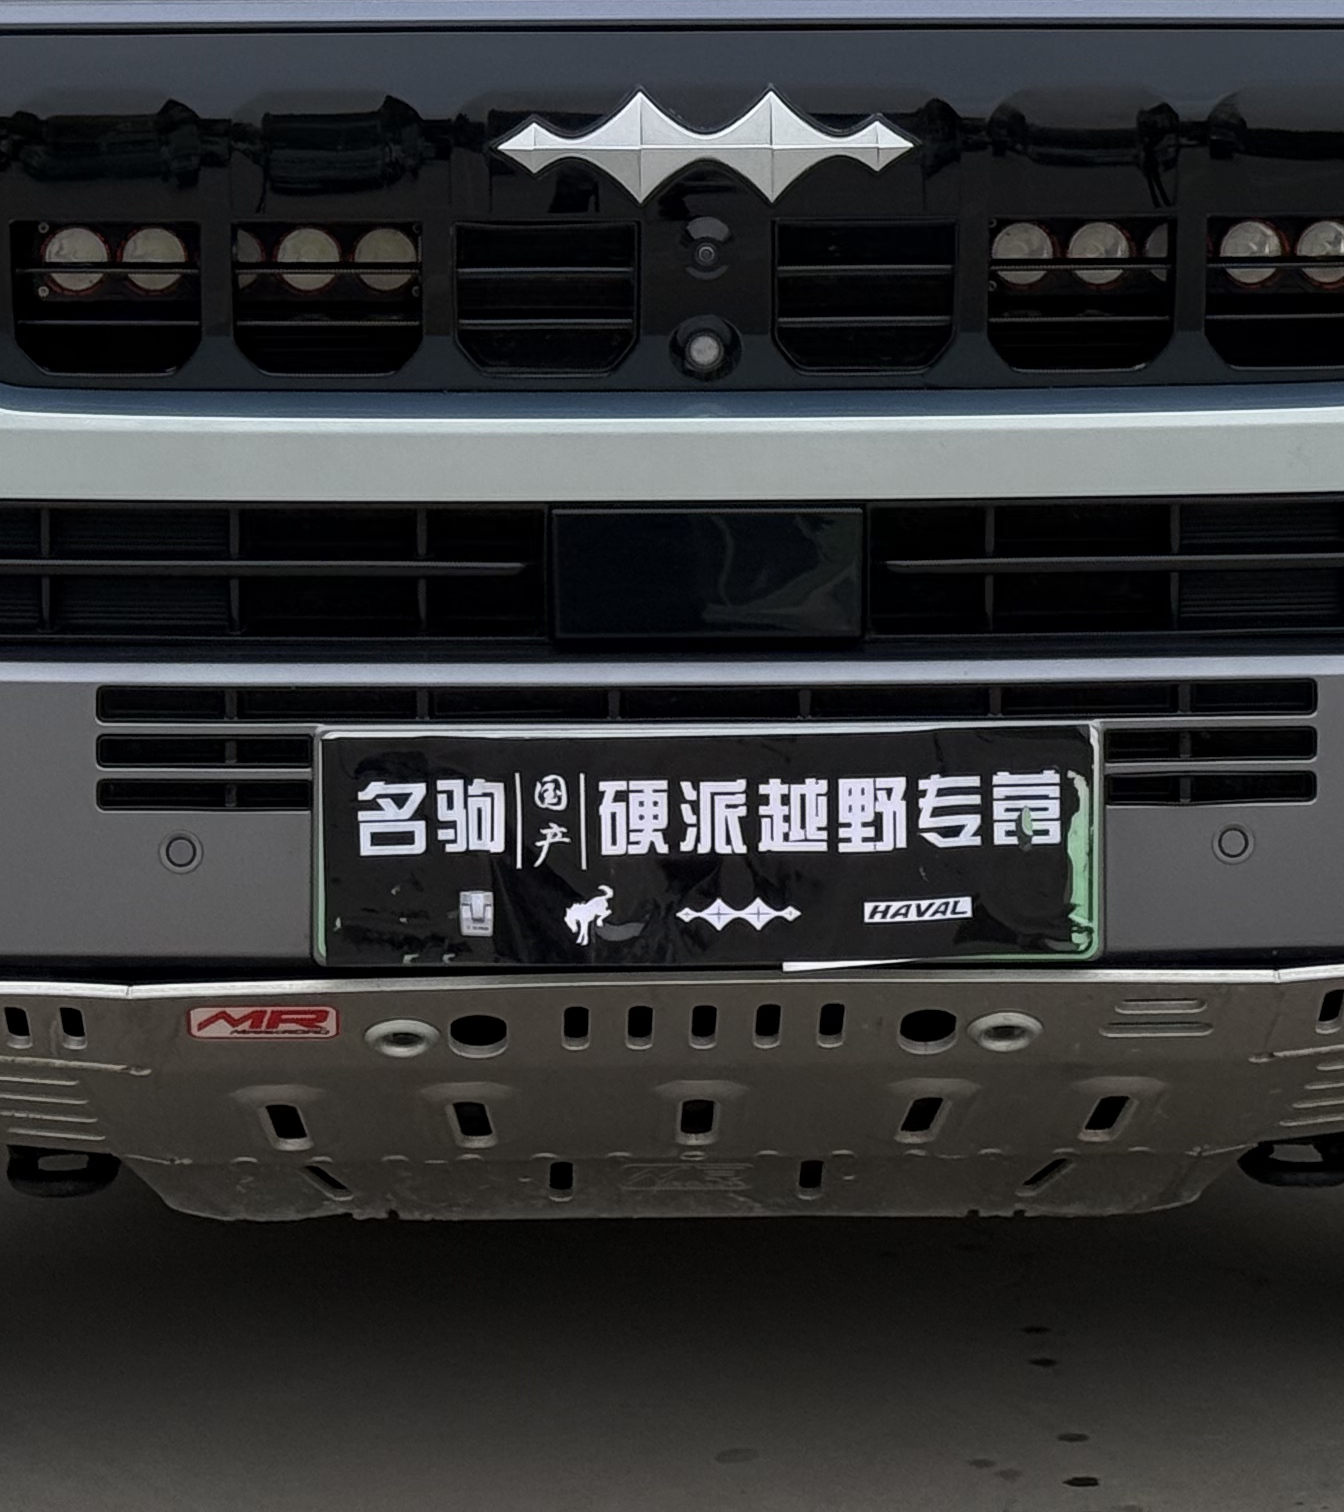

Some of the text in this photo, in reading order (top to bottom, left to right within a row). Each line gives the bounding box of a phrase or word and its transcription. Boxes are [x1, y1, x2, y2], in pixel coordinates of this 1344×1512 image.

[357, 769, 1061, 868] 名驹 国产 硬派越野专营
[867, 899, 968, 920] HAVAL
